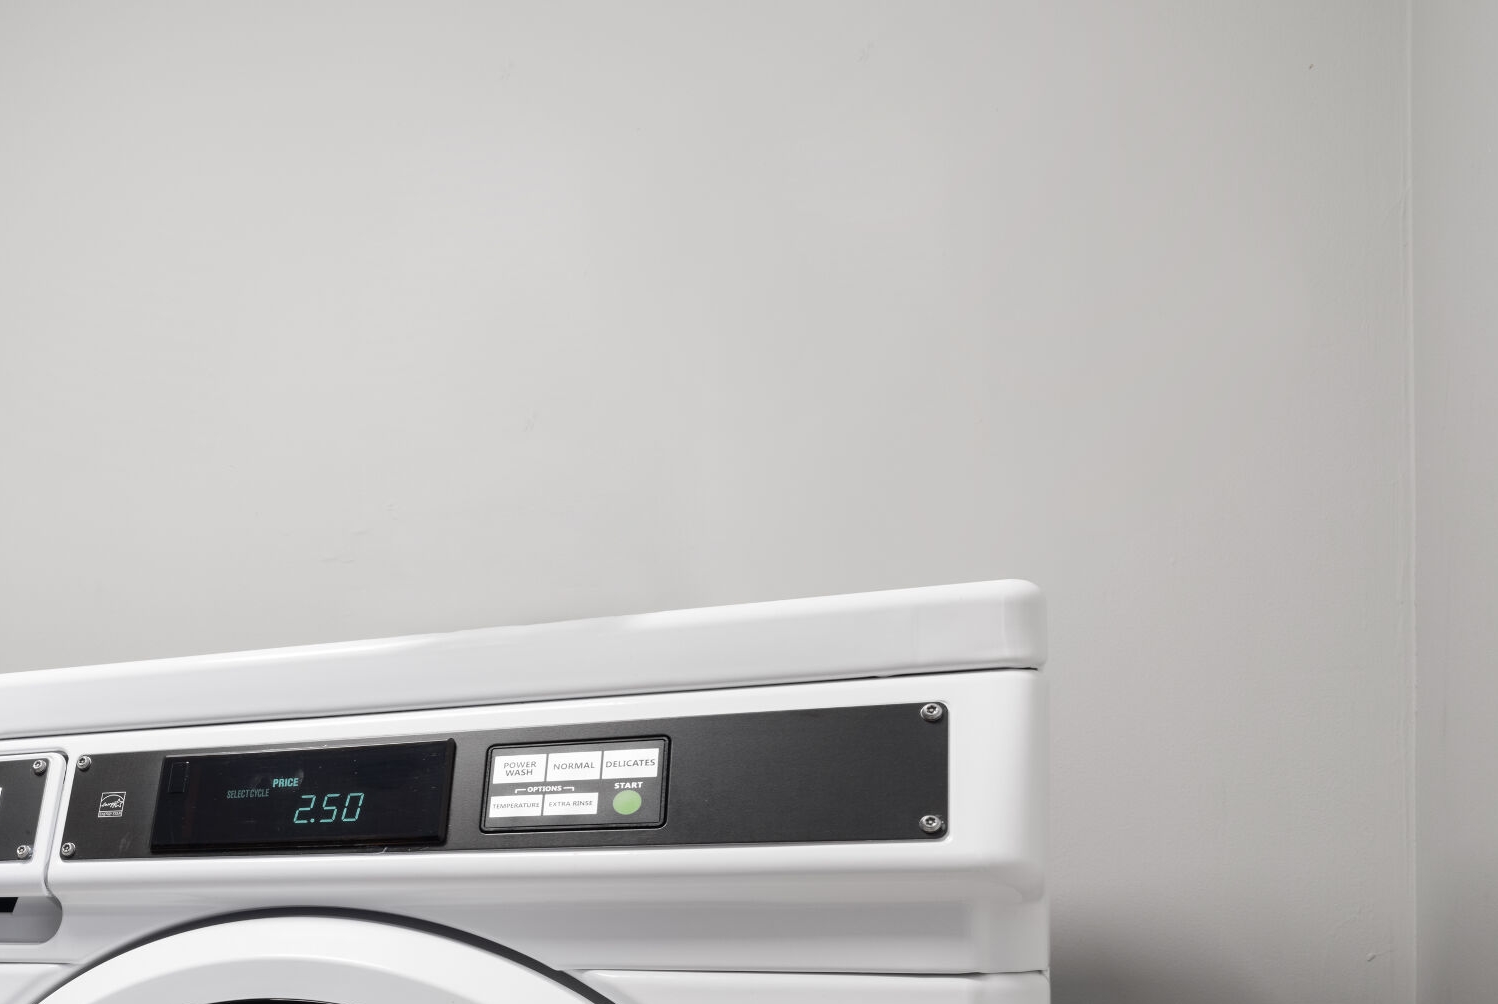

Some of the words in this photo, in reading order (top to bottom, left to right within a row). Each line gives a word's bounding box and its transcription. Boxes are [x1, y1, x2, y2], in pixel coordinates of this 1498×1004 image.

[503, 761, 537, 769] POWER
[553, 762, 595, 770] NORMAL
[605, 759, 656, 768] DELICATES
[505, 768, 533, 777] WASH
[272, 777, 299, 788] PRICE
[527, 785, 562, 793] OPTIONS
[226, 790, 249, 799] SELECT
[250, 789, 270, 798] CYCLE
[293, 792, 365, 824] 2.50
